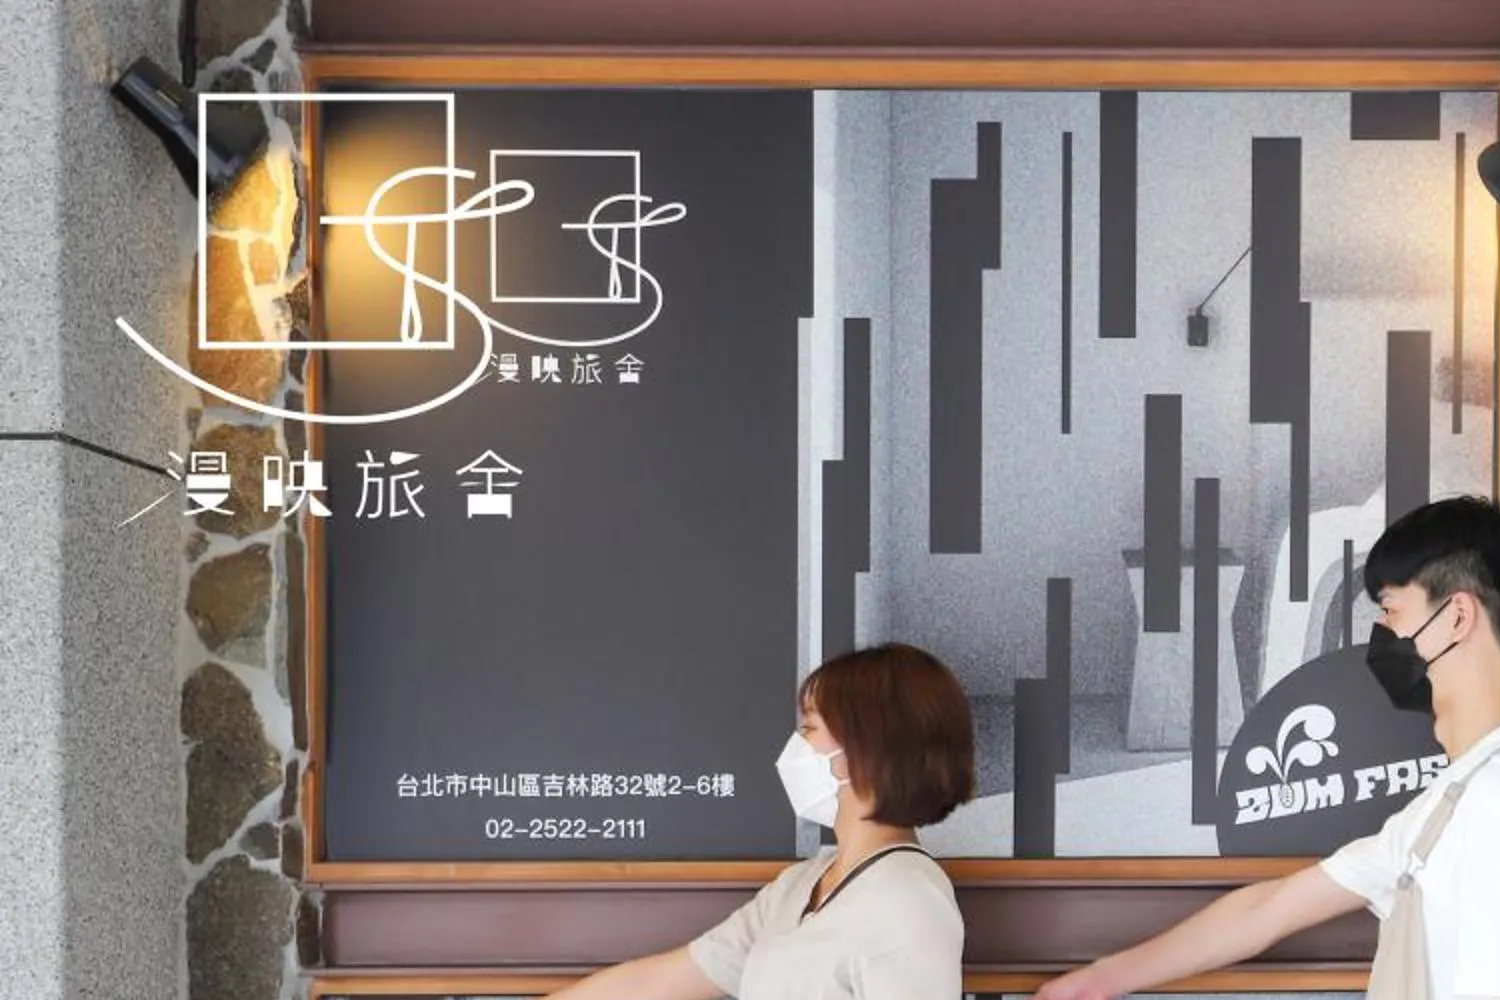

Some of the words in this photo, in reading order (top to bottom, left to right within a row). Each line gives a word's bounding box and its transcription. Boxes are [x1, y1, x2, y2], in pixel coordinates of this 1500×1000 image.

[476, 353, 645, 384] 漫映旅舍
[397, 773, 735, 798] 台北市中山區吉林路32號2-6樓
[1235, 773, 1345, 825] ZUM
[485, 818, 646, 839] 02-2522-2111
